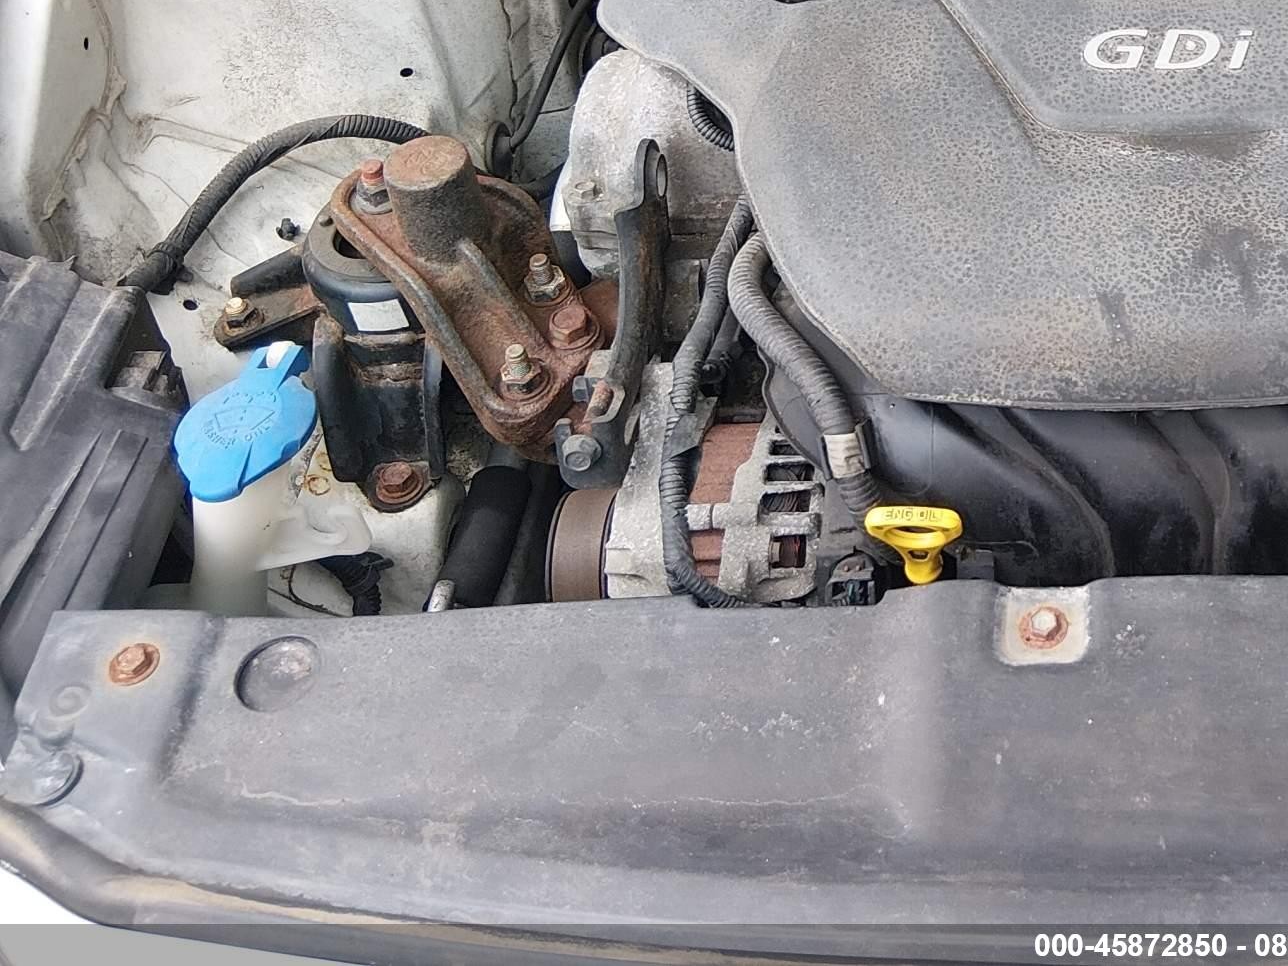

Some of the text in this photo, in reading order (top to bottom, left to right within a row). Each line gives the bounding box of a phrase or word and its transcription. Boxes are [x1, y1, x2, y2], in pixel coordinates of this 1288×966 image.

[1082, 29, 1256, 71] GDi
[885, 508, 939, 523] ENG OIL
